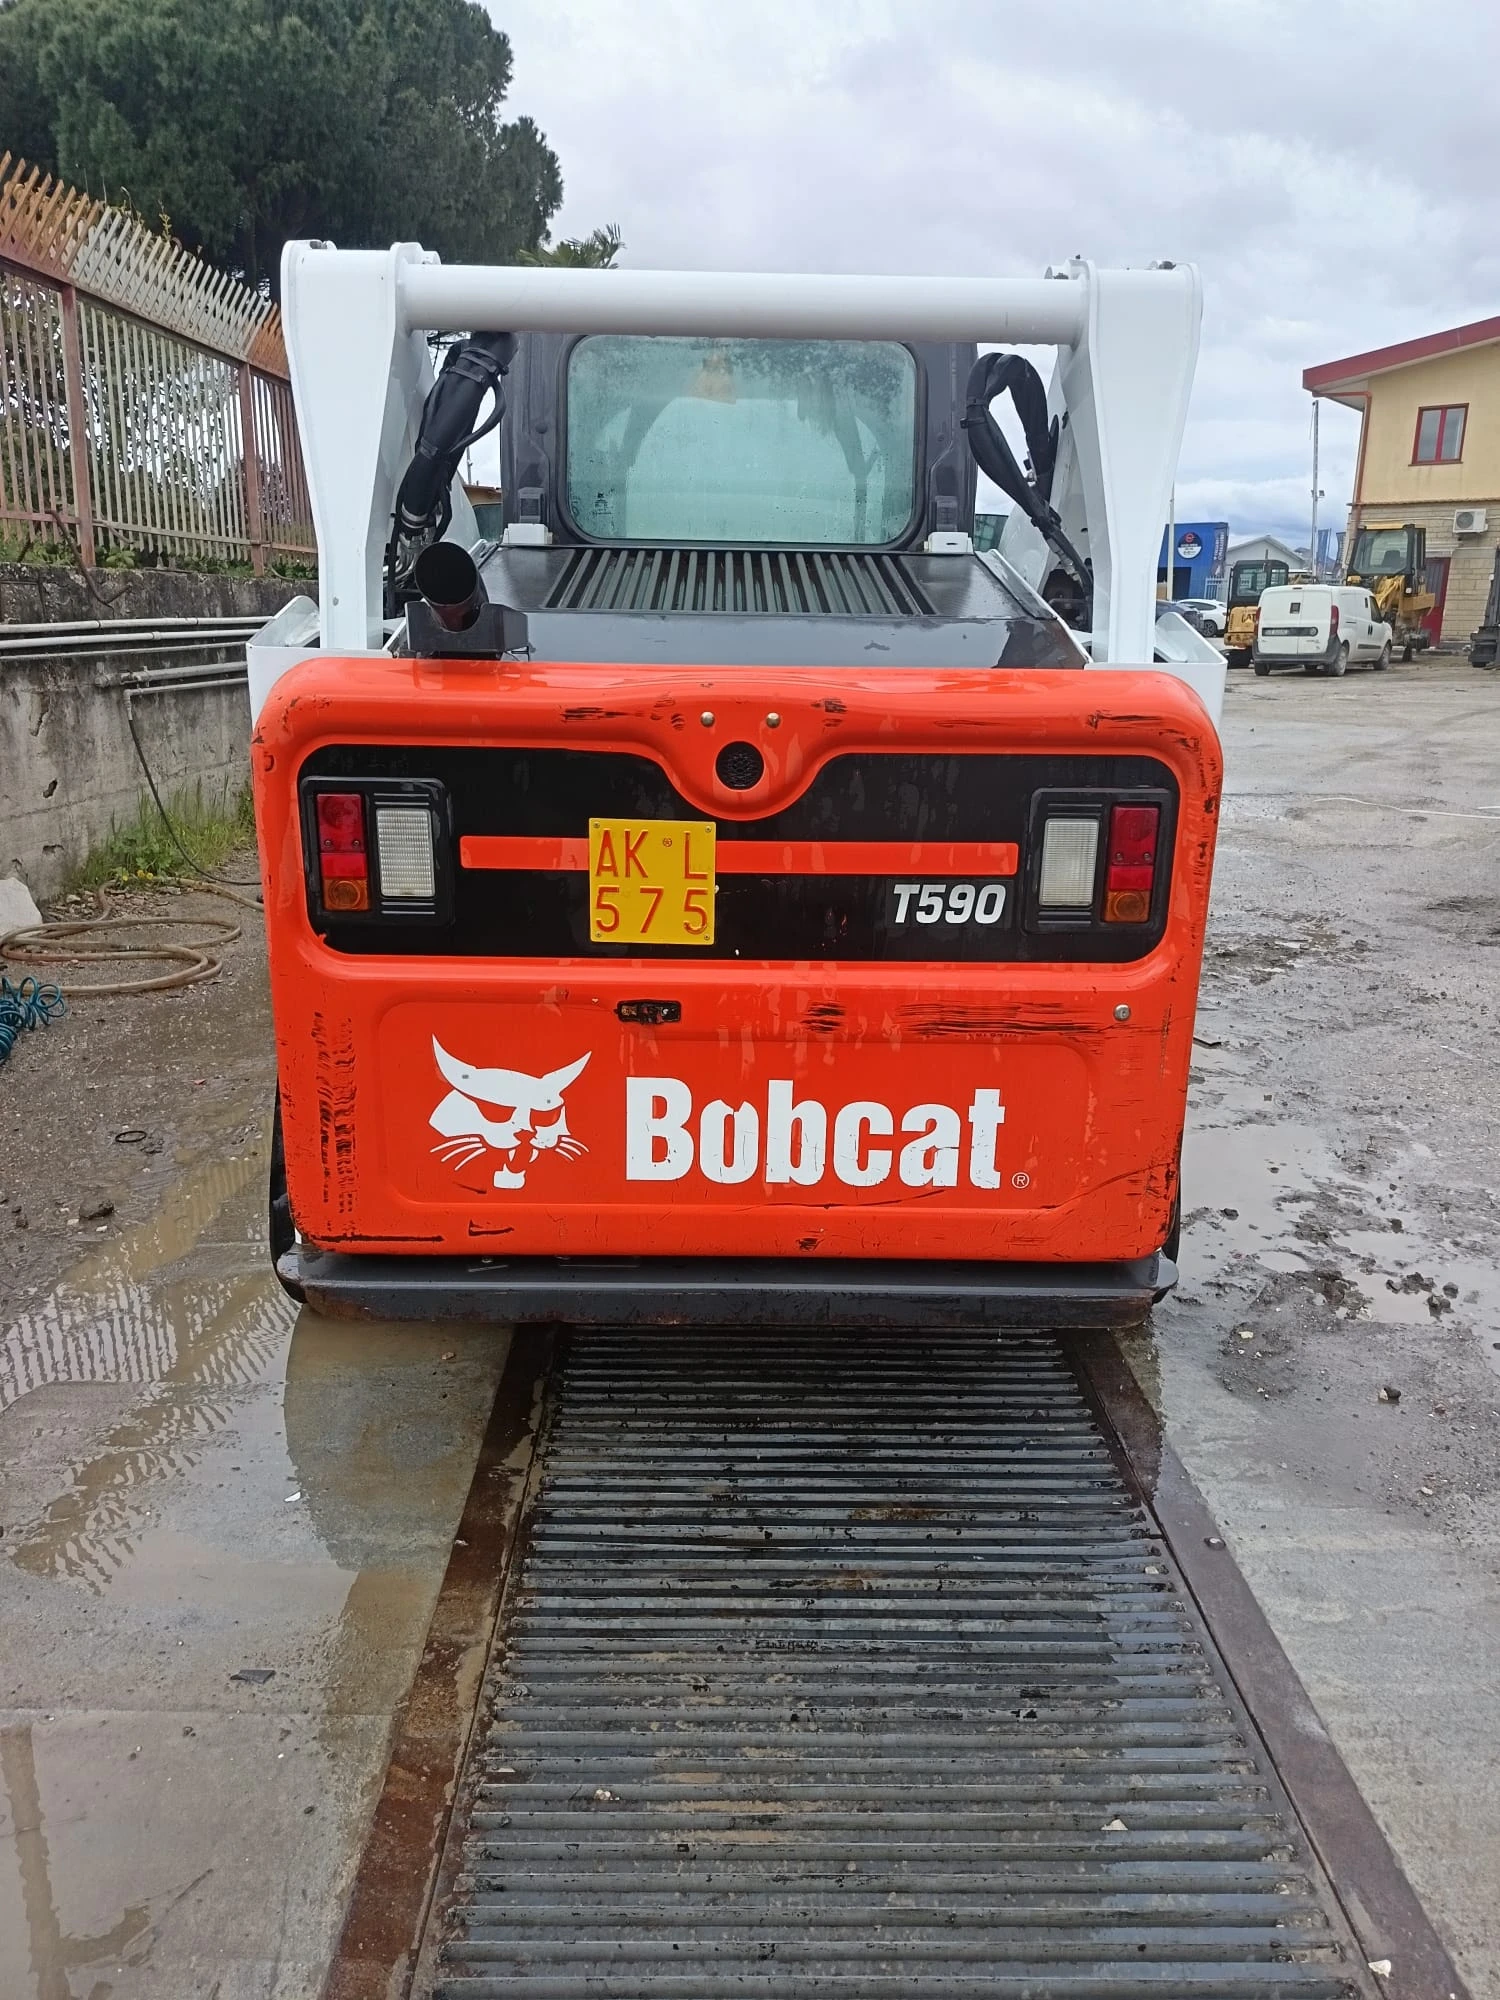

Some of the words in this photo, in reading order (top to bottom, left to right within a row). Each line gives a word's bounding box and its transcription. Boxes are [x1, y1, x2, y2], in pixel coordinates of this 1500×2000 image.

[595, 828, 649, 878] AK
[684, 831, 709, 880] L
[893, 884, 1006, 924] T590
[626, 1076, 1006, 1189] Bobcat
